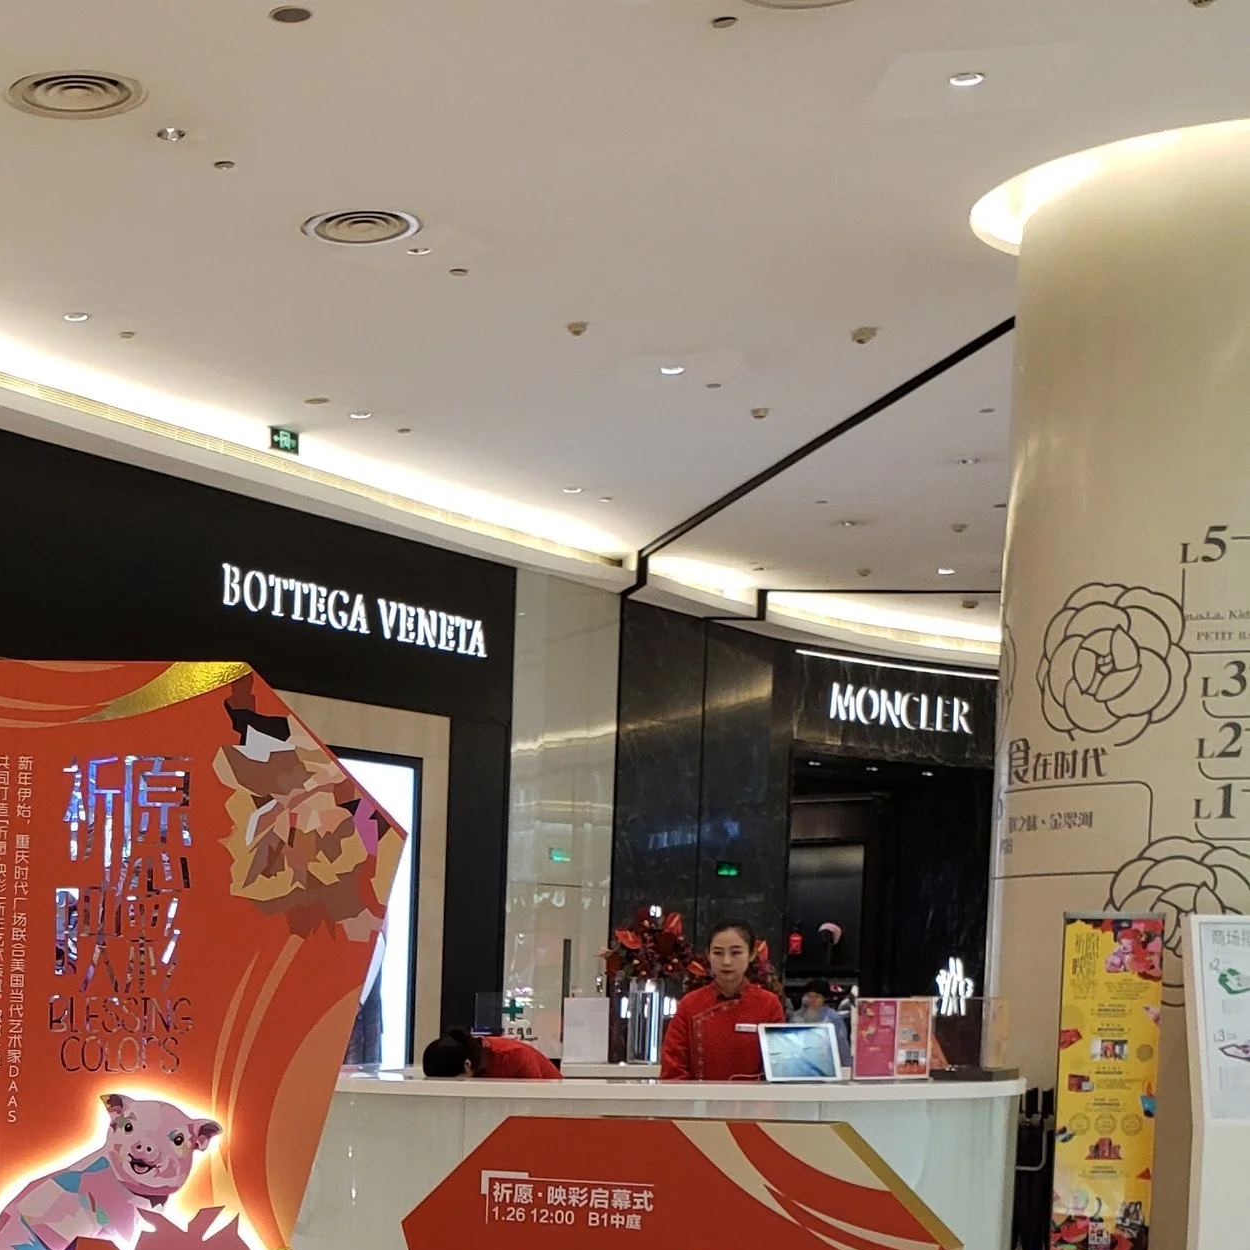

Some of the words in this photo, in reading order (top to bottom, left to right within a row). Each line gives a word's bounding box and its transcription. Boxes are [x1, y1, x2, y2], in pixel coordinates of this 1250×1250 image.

[221, 562, 370, 635] BOTTEGA
[377, 598, 487, 658] VENETA
[829, 682, 973, 735] MONCLER
[49, 996, 194, 1034] BLESSING
[492, 1182, 655, 1212] 祈愿·映彩启幕式
[492, 1206, 526, 1222] 1.26
[530, 1208, 575, 1225] 12:00
[588, 1212, 642, 1230] B1中庭
